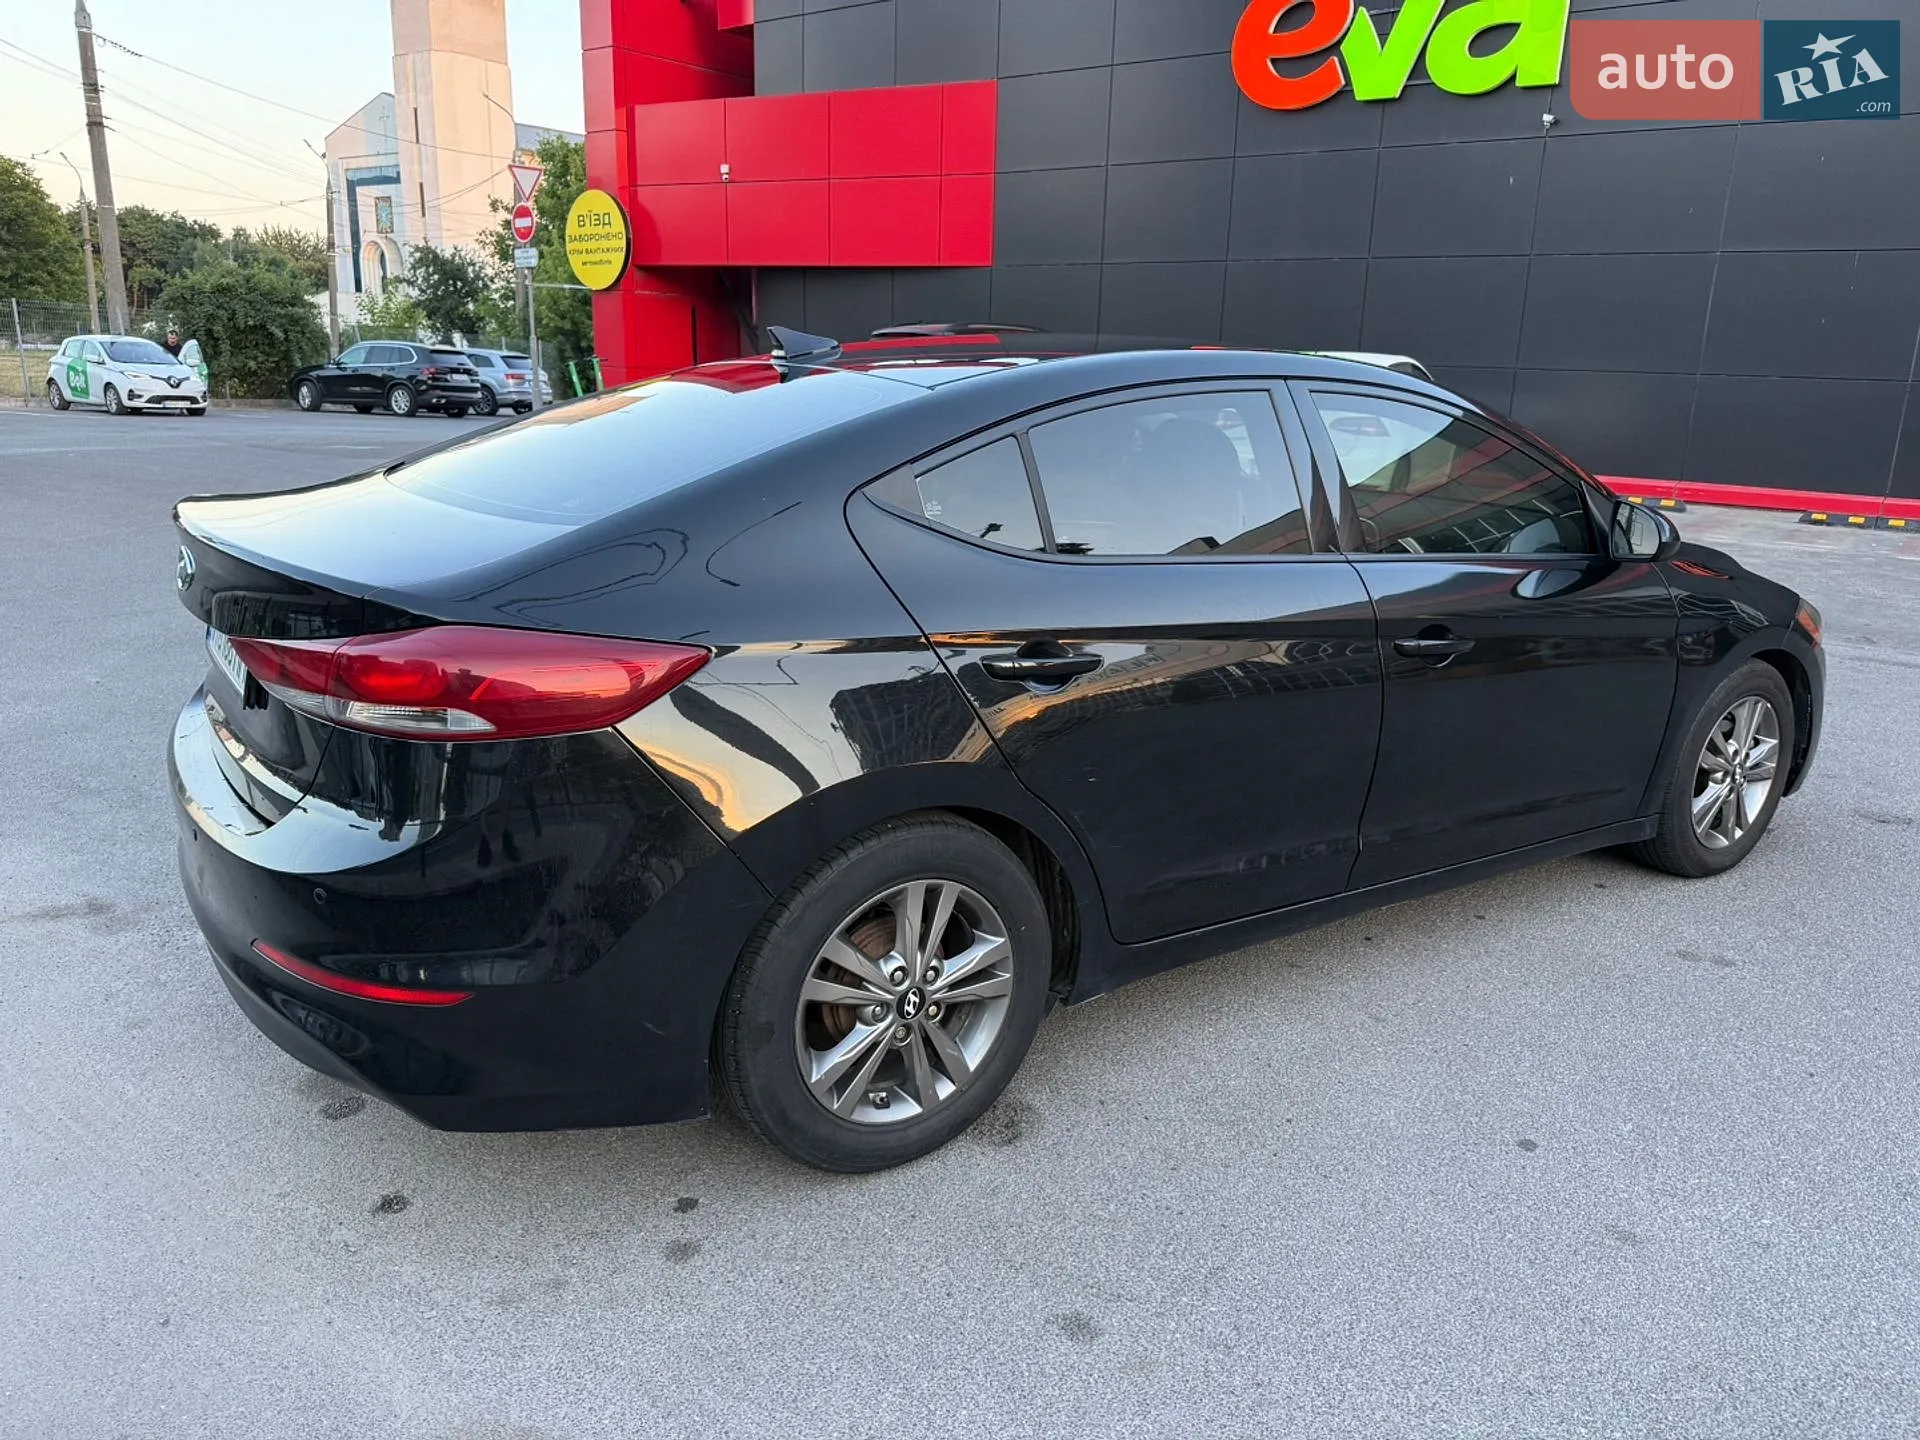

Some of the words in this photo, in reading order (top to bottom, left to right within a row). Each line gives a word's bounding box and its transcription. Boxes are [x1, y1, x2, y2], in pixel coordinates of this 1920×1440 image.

[1230, 0, 1570, 110] eva
[577, 210, 612, 228] В'ЇЗД
[568, 232, 624, 243] ЗАБОРОНЕНО
[585, 246, 624, 256] ВАНТАЖНИХ
